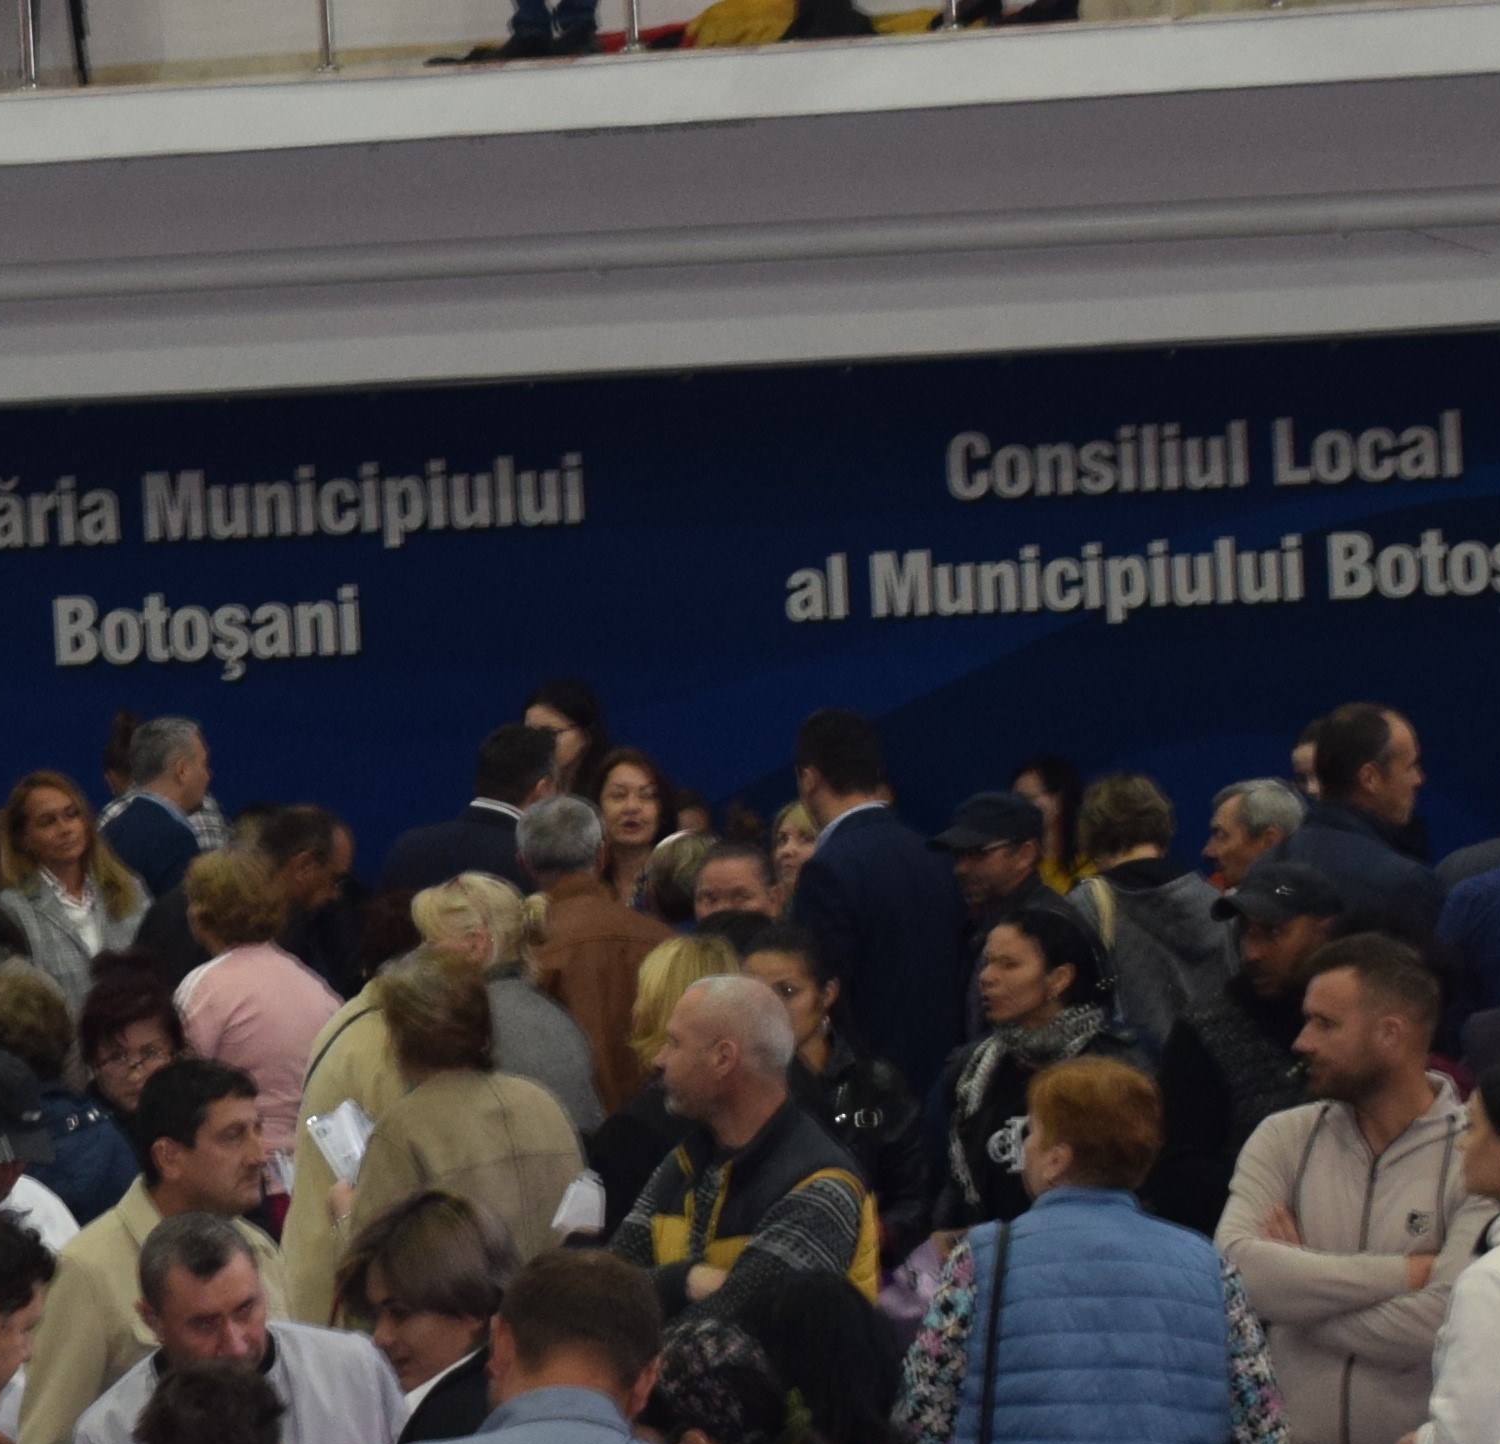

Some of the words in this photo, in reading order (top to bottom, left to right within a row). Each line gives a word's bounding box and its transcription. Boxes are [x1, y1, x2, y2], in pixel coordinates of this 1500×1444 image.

[142, 453, 585, 548] Municipiului
[946, 420, 1249, 500] Consiliul
[1272, 409, 1463, 485] Local
[785, 552, 847, 620] al
[869, 532, 1304, 624] Municipiului
